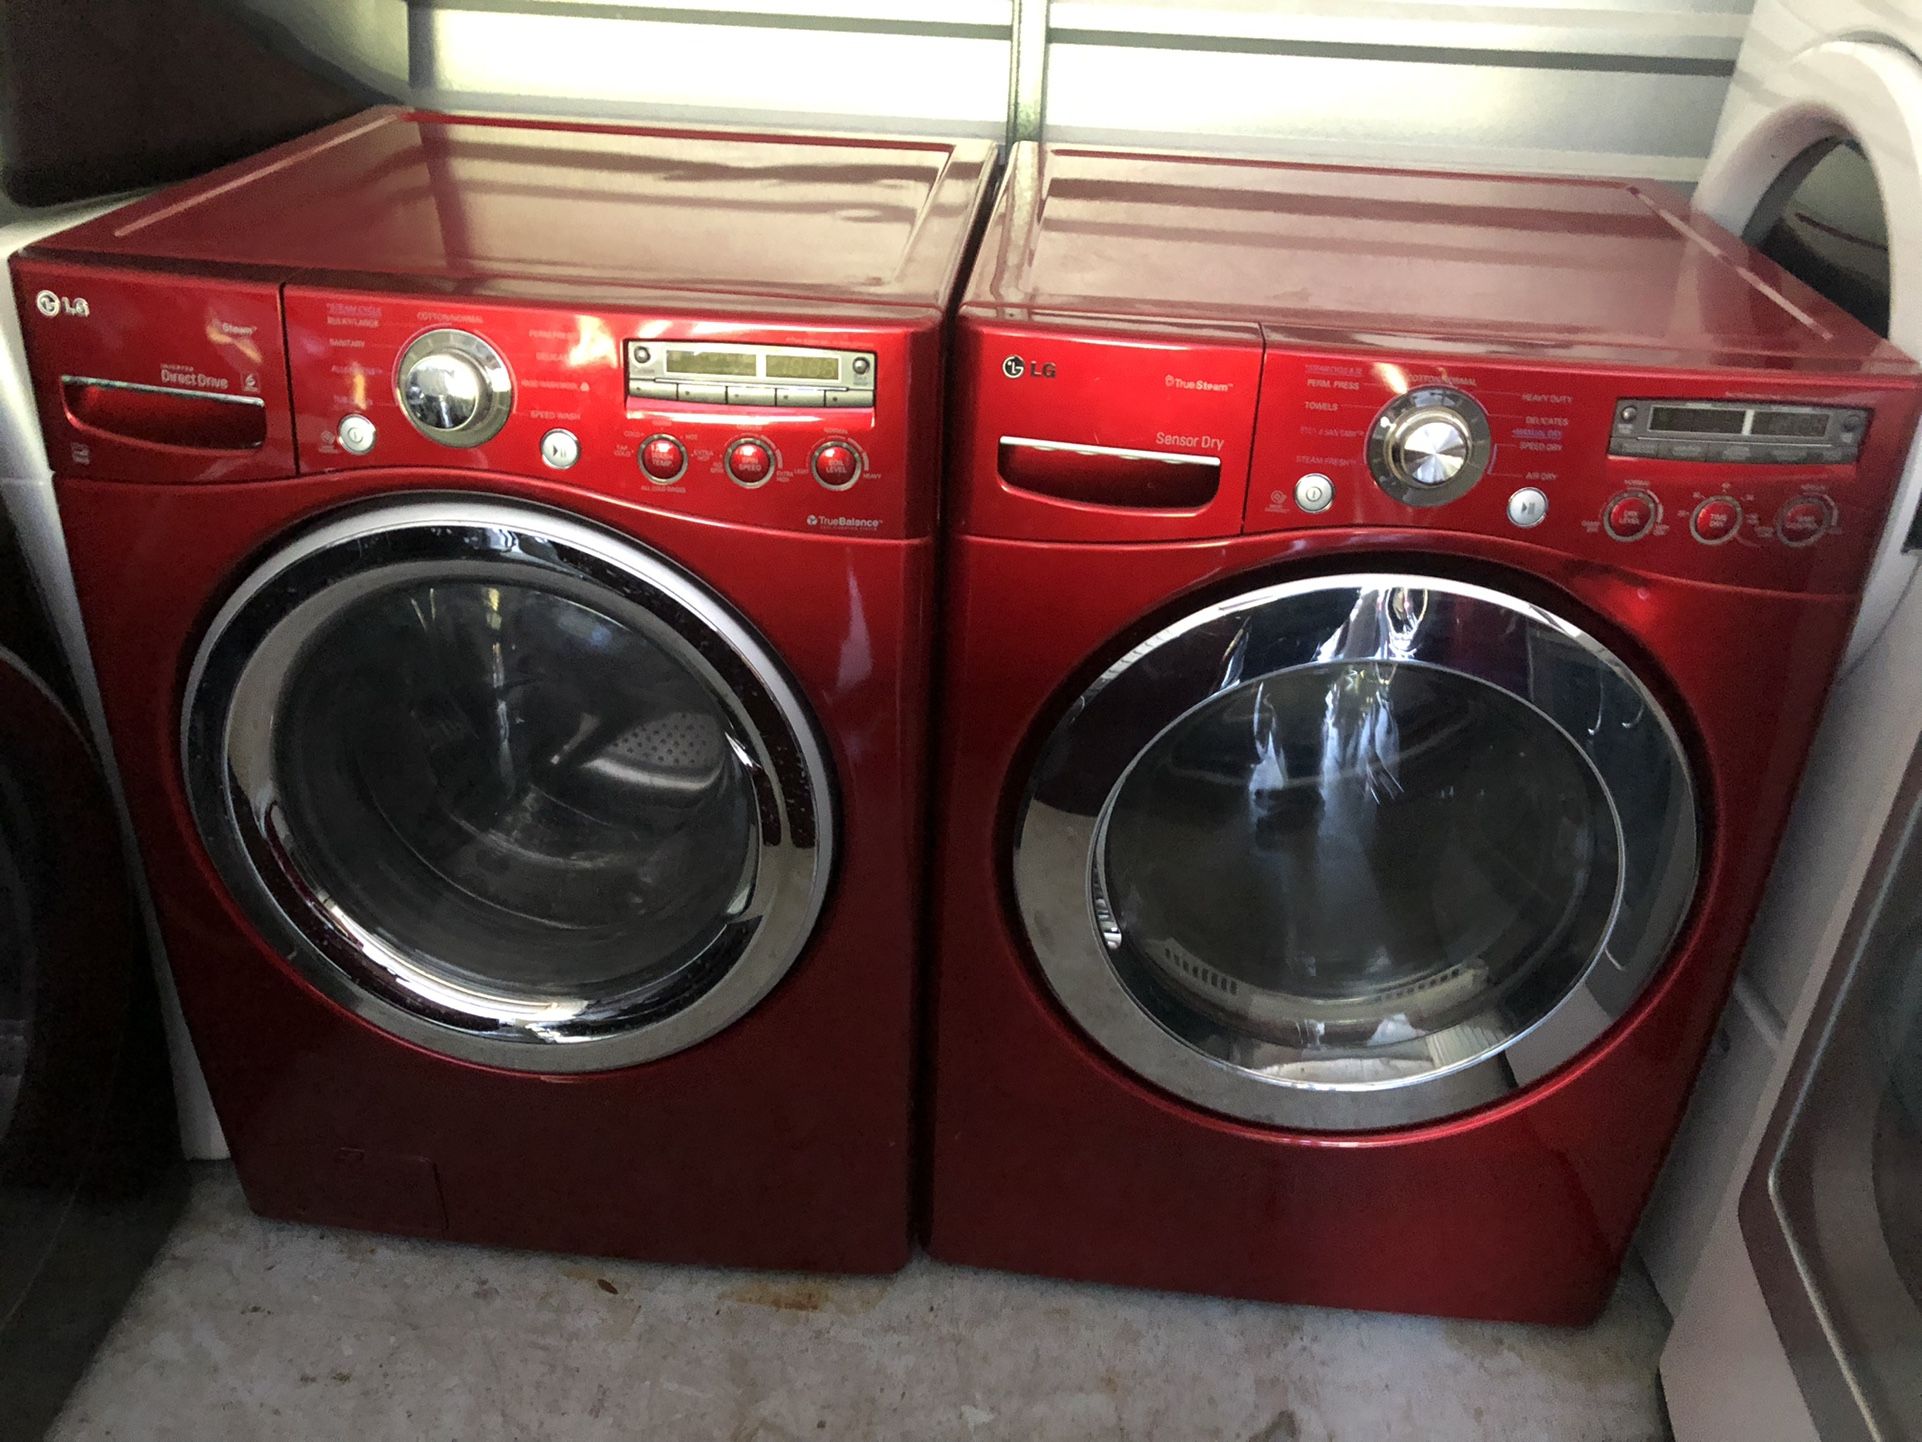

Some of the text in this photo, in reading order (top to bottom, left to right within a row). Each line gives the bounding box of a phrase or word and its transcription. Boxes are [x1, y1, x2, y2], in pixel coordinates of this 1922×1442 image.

[62, 297, 90, 318] LG
[1030, 361, 1056, 379] LG
[160, 369, 229, 390] Direct Drive
[1333, 380, 1360, 391] PRESS
[1522, 393, 1548, 402] HEAVY
[1304, 401, 1339, 411] TOWELS
[1525, 416, 1569, 426] DELICATES
[1155, 432, 1225, 452] Sensor Dry
[1519, 441, 1544, 451] SPEED
[738, 464, 762, 474] SPEED
[826, 467, 848, 476] LEVEL
[819, 516, 880, 528] TrueBalance
